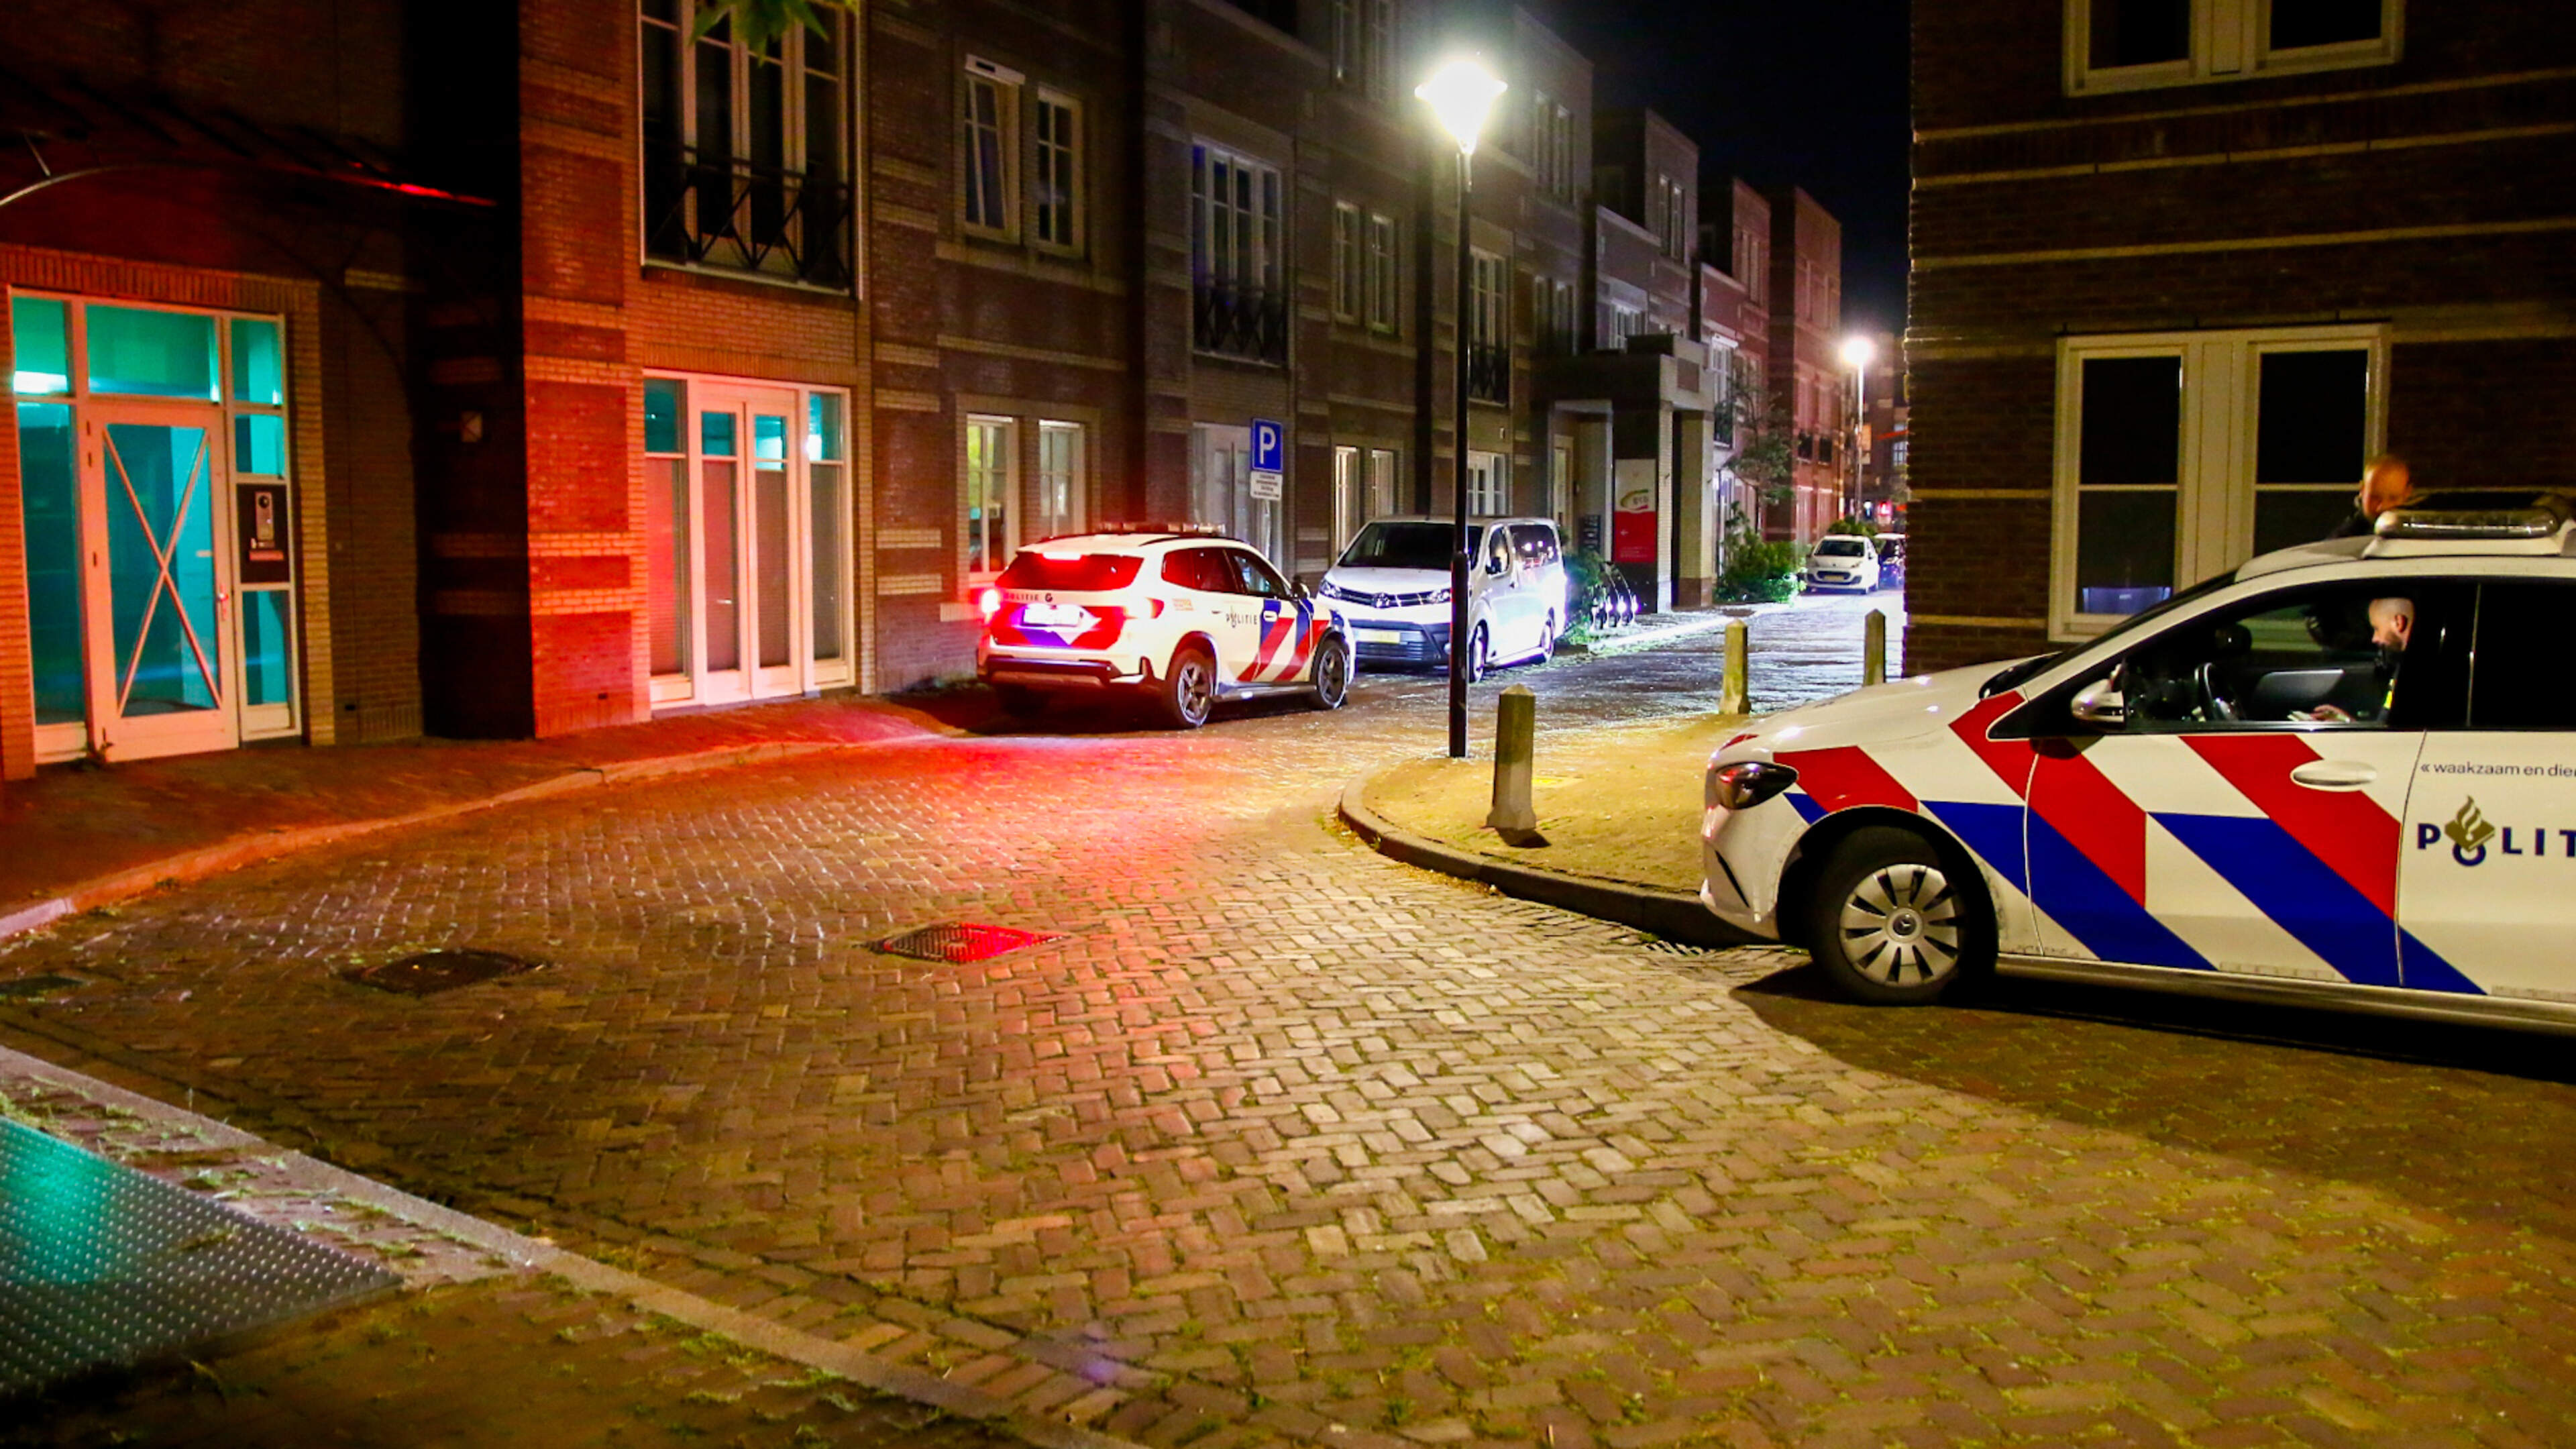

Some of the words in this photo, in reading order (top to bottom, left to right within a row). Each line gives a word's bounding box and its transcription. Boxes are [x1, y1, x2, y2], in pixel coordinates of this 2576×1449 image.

[1259, 425, 1276, 464] P
[1226, 613, 1256, 628] POLITIE
[2434, 762, 2520, 775] waakzaam
[2524, 765, 2544, 776] en
[2548, 764, 2576, 777] die
[2417, 822, 2576, 867] POLIT
